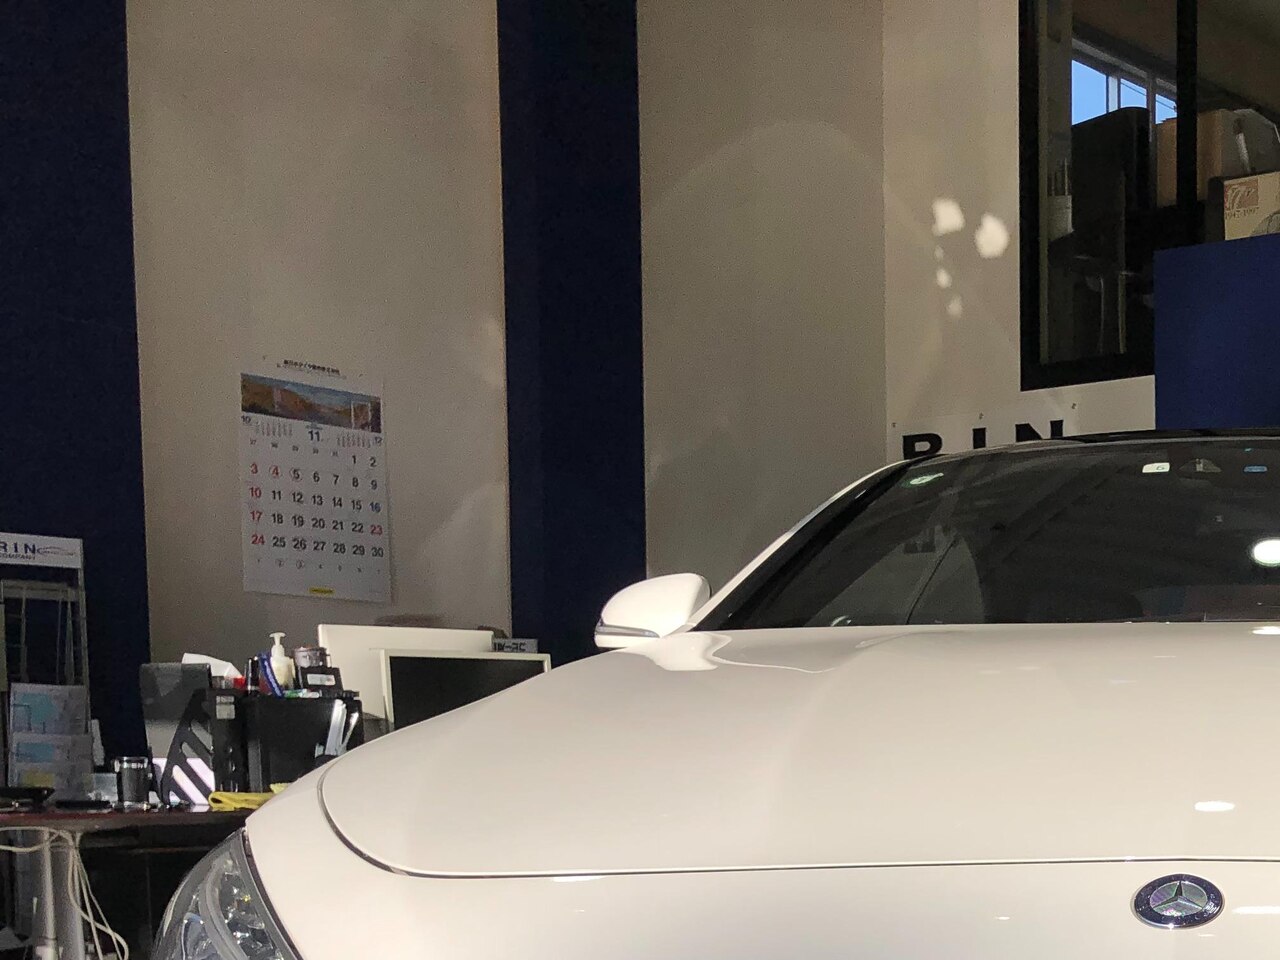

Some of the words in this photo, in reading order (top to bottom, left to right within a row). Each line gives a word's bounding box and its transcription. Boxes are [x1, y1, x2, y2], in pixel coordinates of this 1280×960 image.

[308, 430, 321, 442] 11
[352, 455, 357, 464] 1
[369, 457, 377, 467] 2
[250, 463, 258, 474] 3
[271, 465, 280, 477] 4
[292, 469, 300, 480] 5
[313, 471, 320, 483] 6
[333, 474, 340, 485] 7
[352, 477, 359, 488] 8
[371, 479, 378, 490] 9
[249, 487, 262, 499] 10
[271, 490, 282, 500] 11
[292, 492, 303, 504] 12
[311, 494, 323, 506] 13
[332, 496, 343, 508] 14
[351, 500, 362, 511] 15
[369, 502, 381, 513] 16
[250, 511, 263, 522] 17
[271, 513, 284, 525] 18
[292, 515, 304, 527] 19
[311, 518, 326, 529] 20
[332, 519, 344, 531] 21
[351, 522, 364, 533] 22
[370, 524, 383, 536] 23
[251, 534, 265, 545] 24
[272, 536, 286, 548] 25
[292, 537, 307, 550] 26
[313, 541, 326, 551] 27
[333, 543, 346, 554] 28
[352, 544, 366, 556] 29
[371, 547, 384, 558] 30
